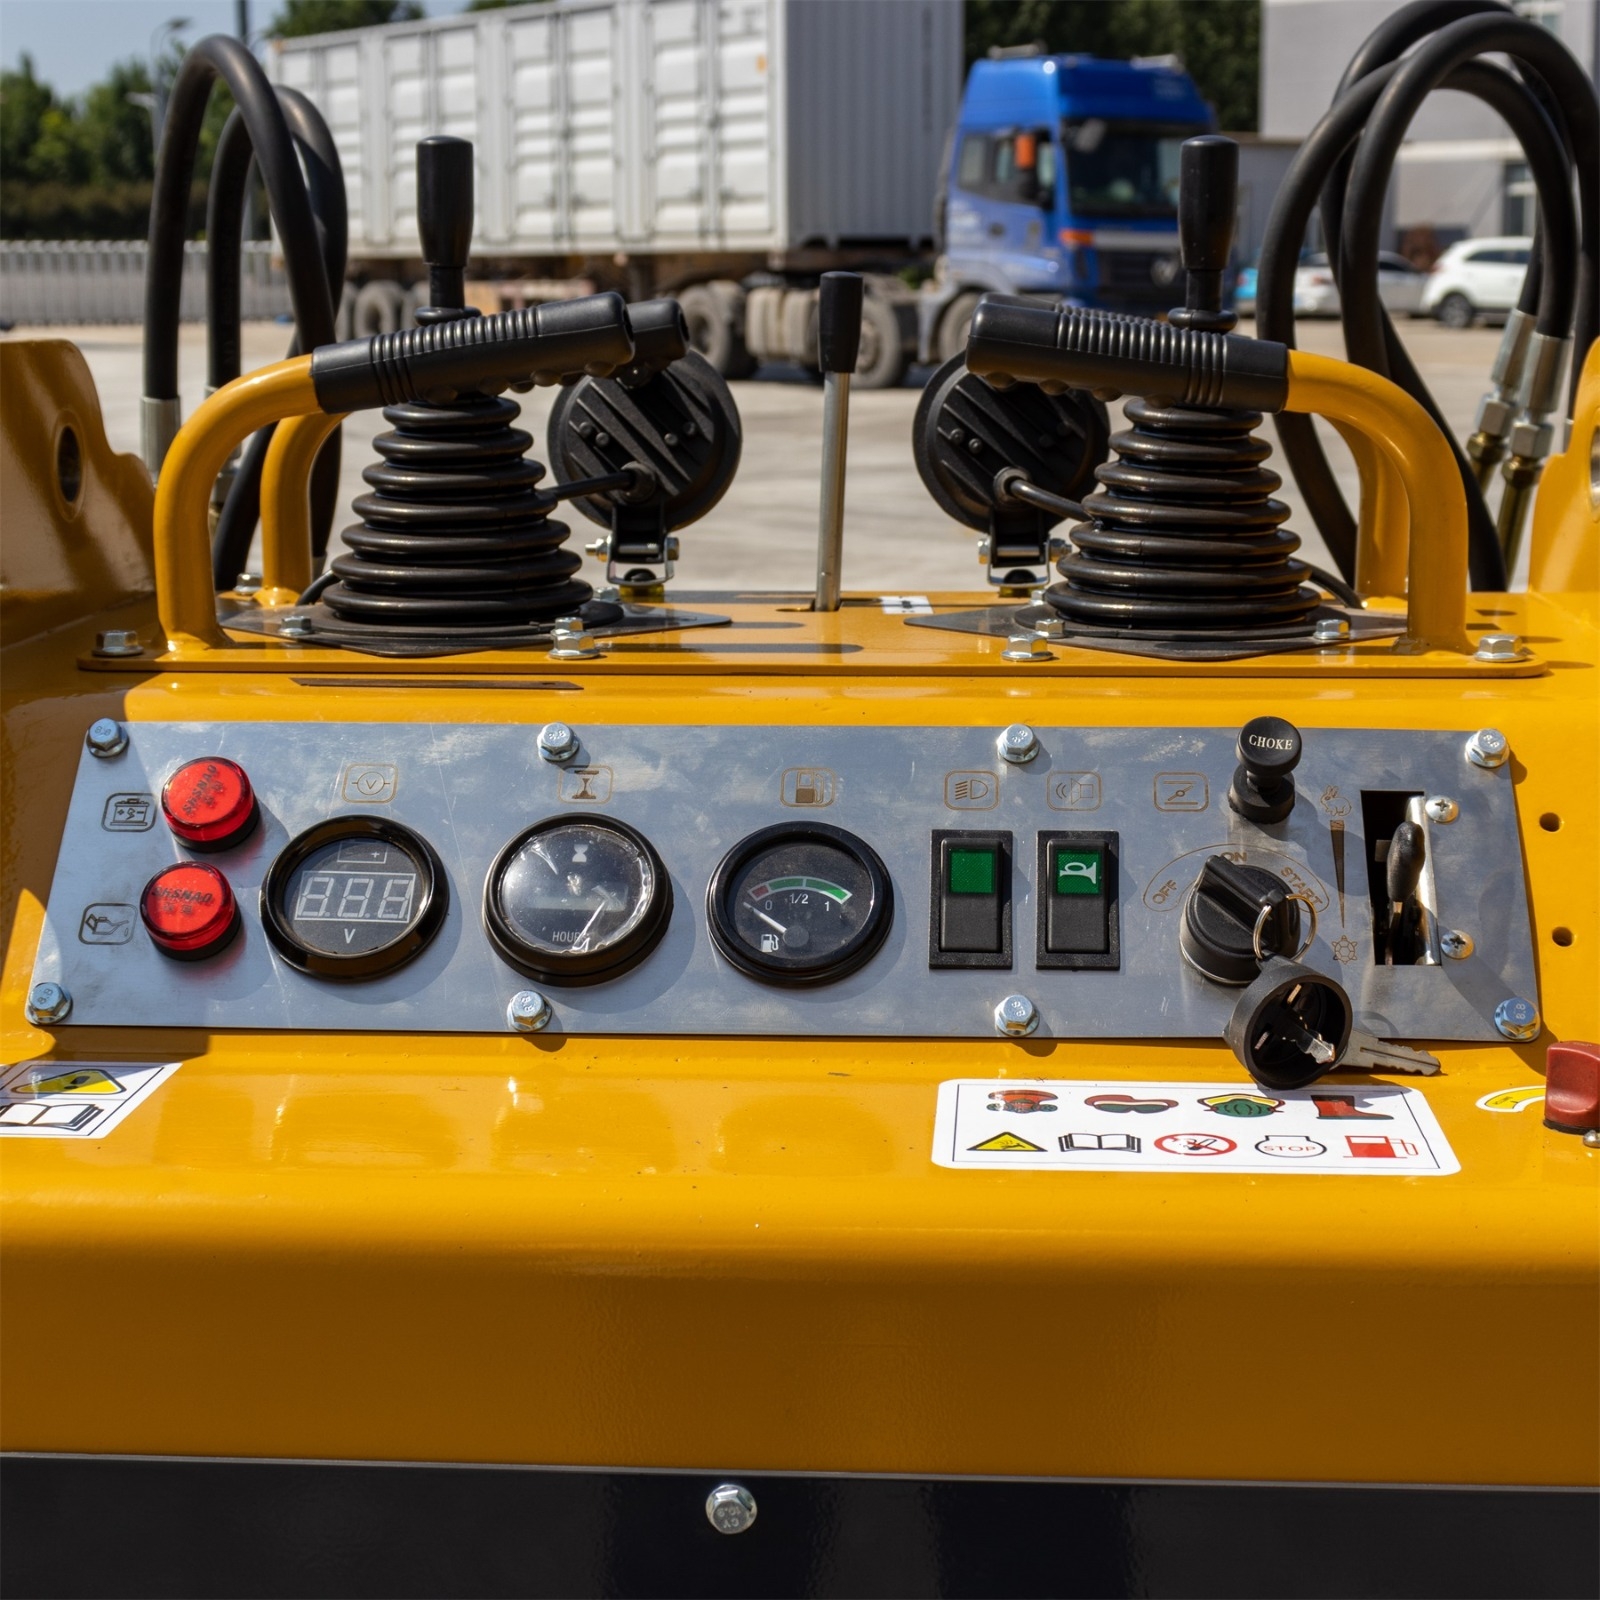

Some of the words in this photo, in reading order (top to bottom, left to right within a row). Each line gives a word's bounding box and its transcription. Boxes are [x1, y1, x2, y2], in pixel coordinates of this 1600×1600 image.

[1248, 734, 1293, 750] CHOKE
[1221, 852, 1248, 863] ON
[1152, 879, 1178, 905] OFF
[1280, 866, 1323, 906] START
[764, 900, 773, 911] 0
[789, 893, 809, 905] 1/2
[824, 901, 830, 912] 1
[344, 928, 356, 944] V
